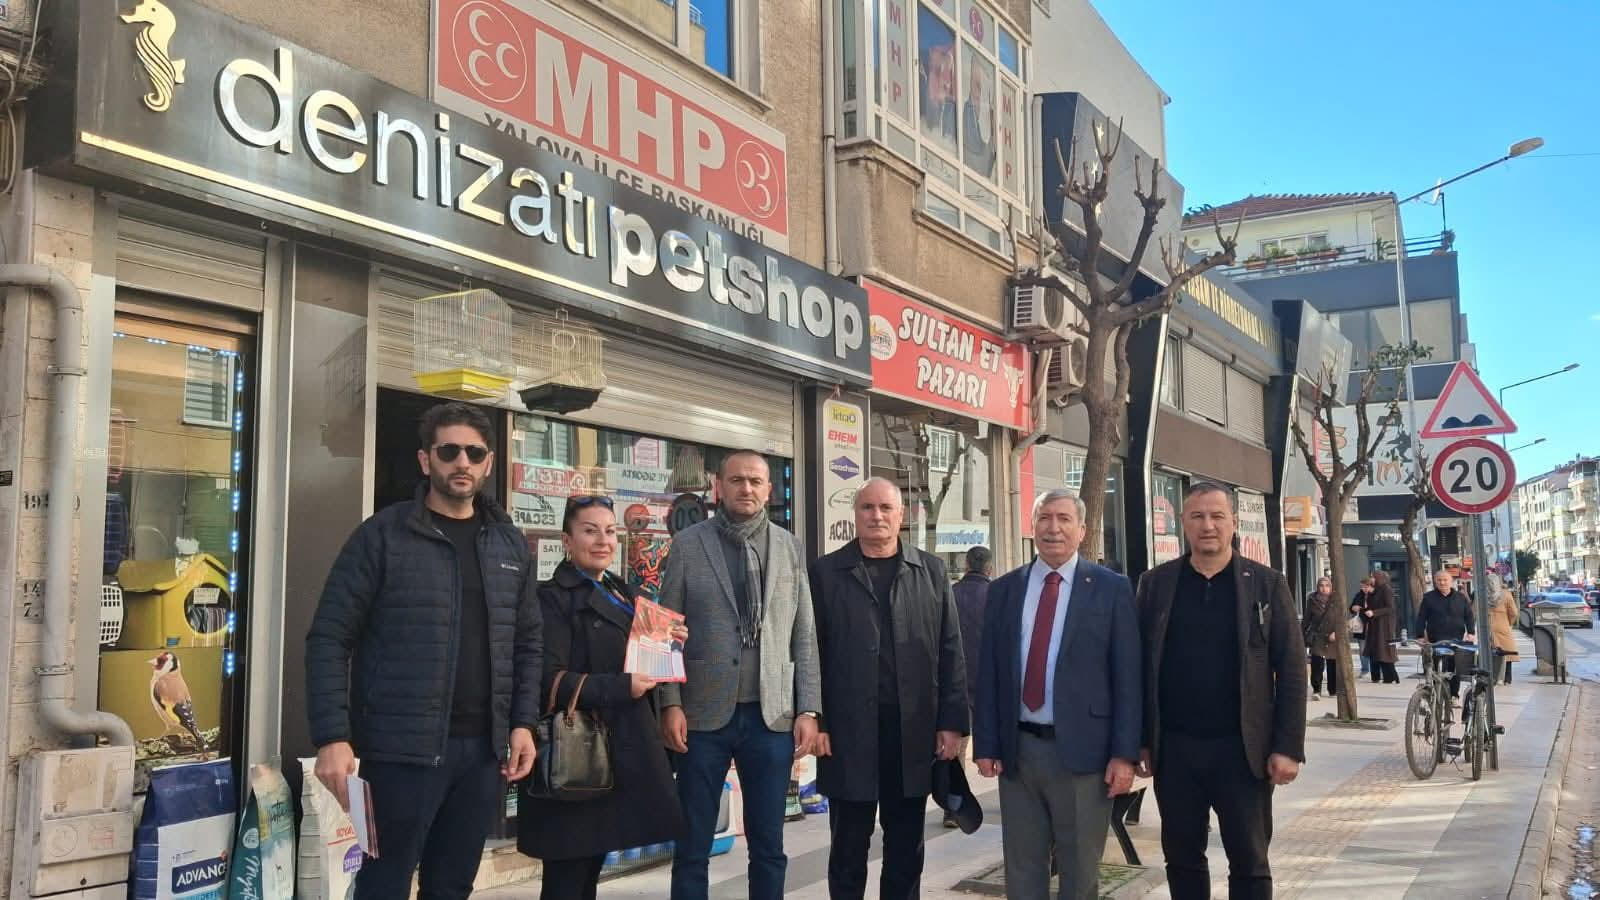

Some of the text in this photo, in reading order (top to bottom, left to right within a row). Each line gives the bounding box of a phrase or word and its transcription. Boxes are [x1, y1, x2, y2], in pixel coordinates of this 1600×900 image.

[535, 28, 726, 192] MHP
[215, 47, 862, 358] denizatı petshop
[898, 307, 1003, 375] SULTAN ET
[916, 356, 988, 408] PAZARI
[828, 430, 858, 444] EHEIM
[1448, 456, 1499, 493] 20
[829, 519, 855, 541] ACAN
